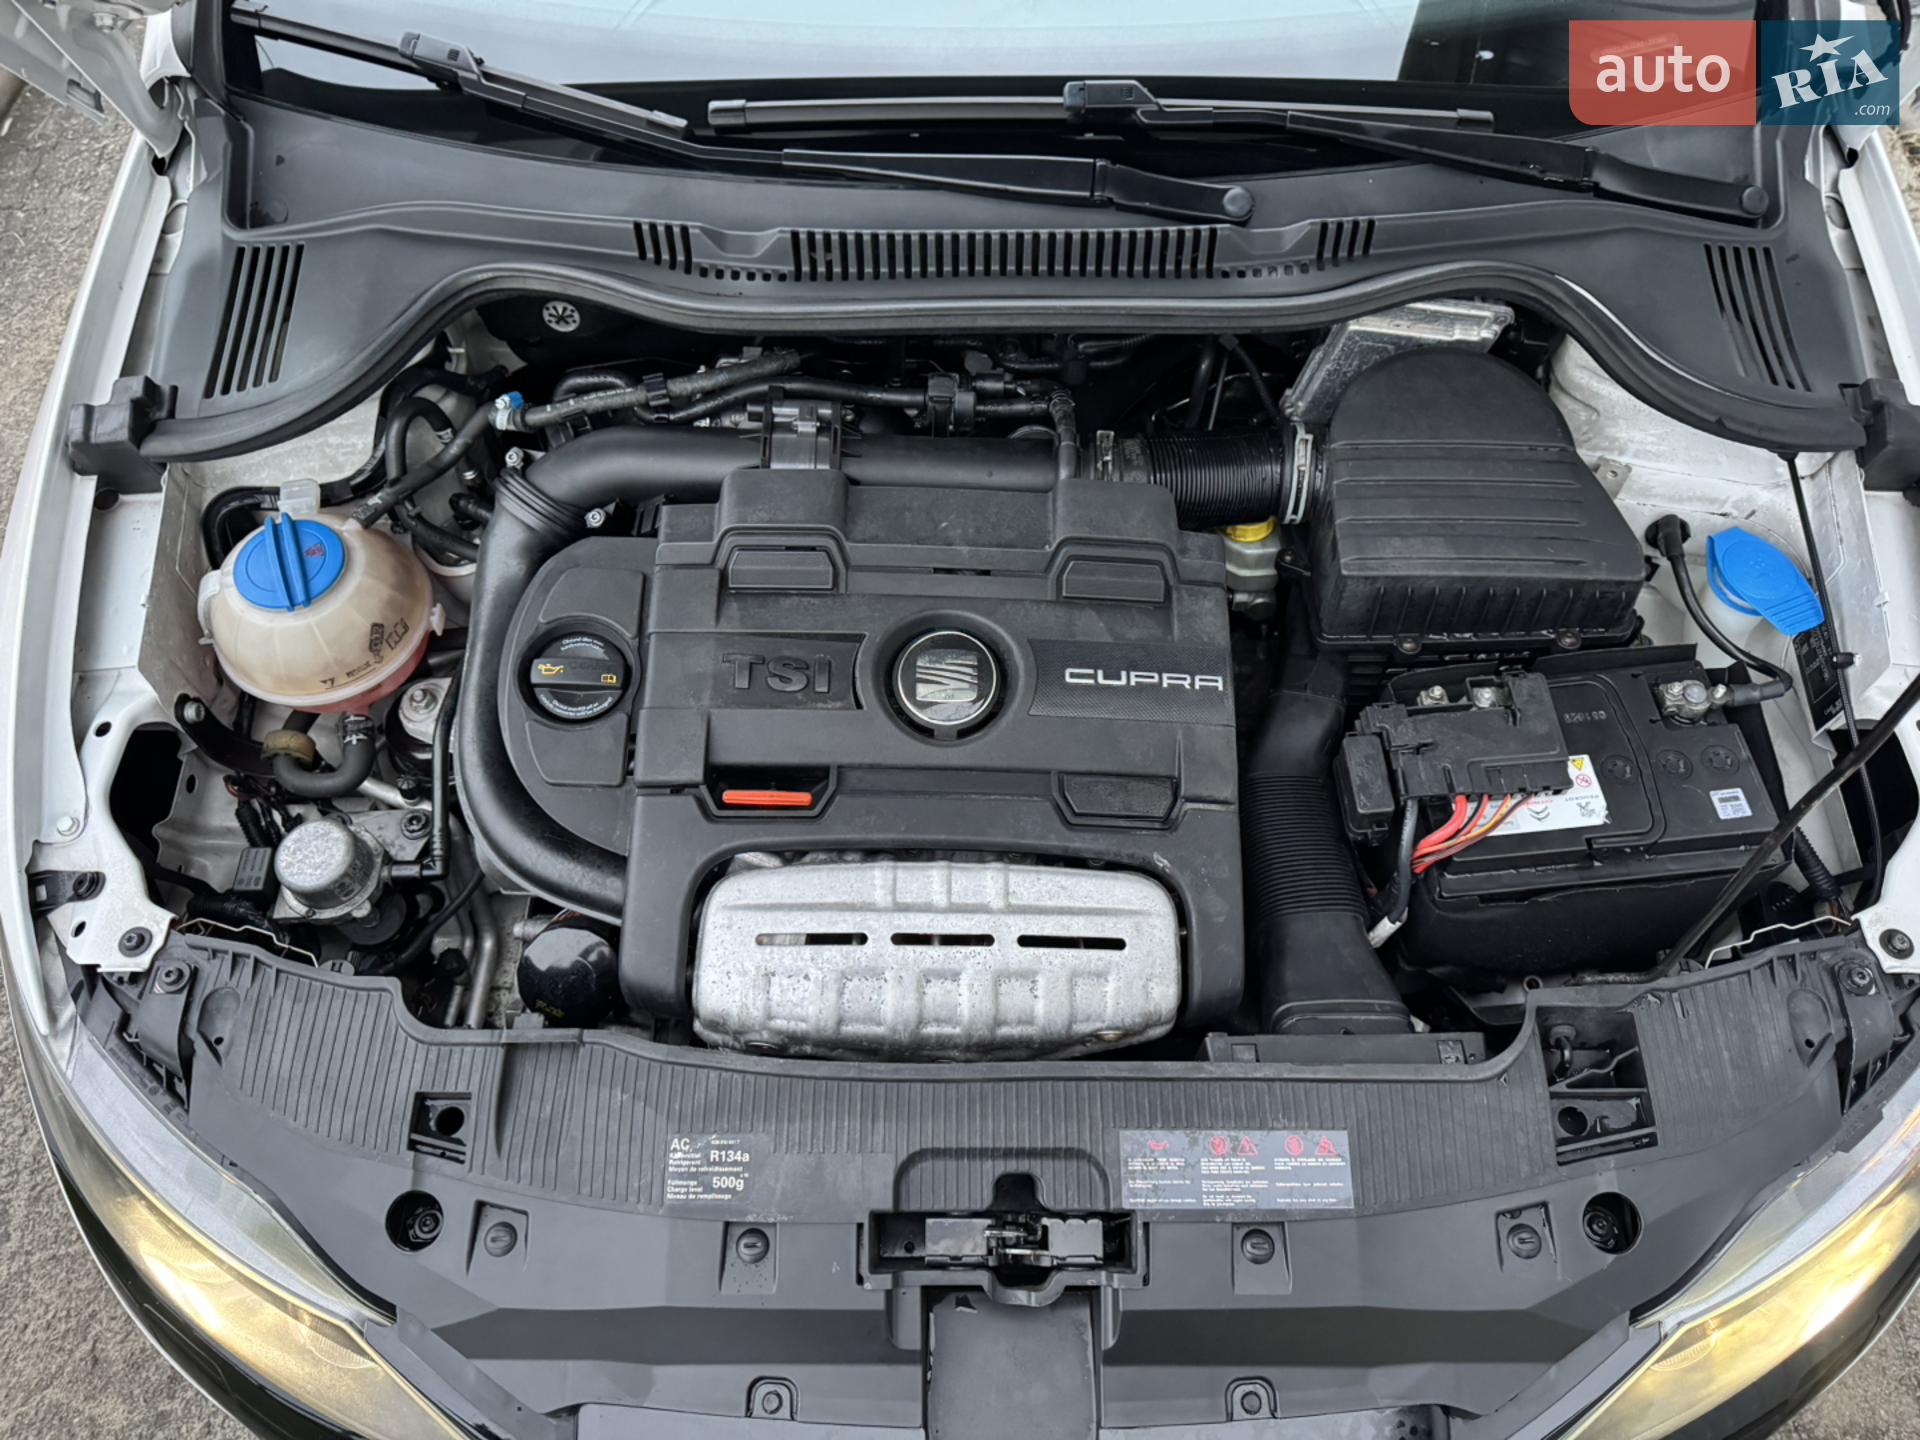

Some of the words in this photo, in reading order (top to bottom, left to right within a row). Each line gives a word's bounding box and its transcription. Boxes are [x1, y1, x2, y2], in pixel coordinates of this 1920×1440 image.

[722, 653, 831, 695] TSI
[1064, 668, 1224, 692] CUPRA
[670, 1138, 690, 1150] AC
[710, 1150, 750, 1162] R134a
[713, 1177, 744, 1191] 500g
